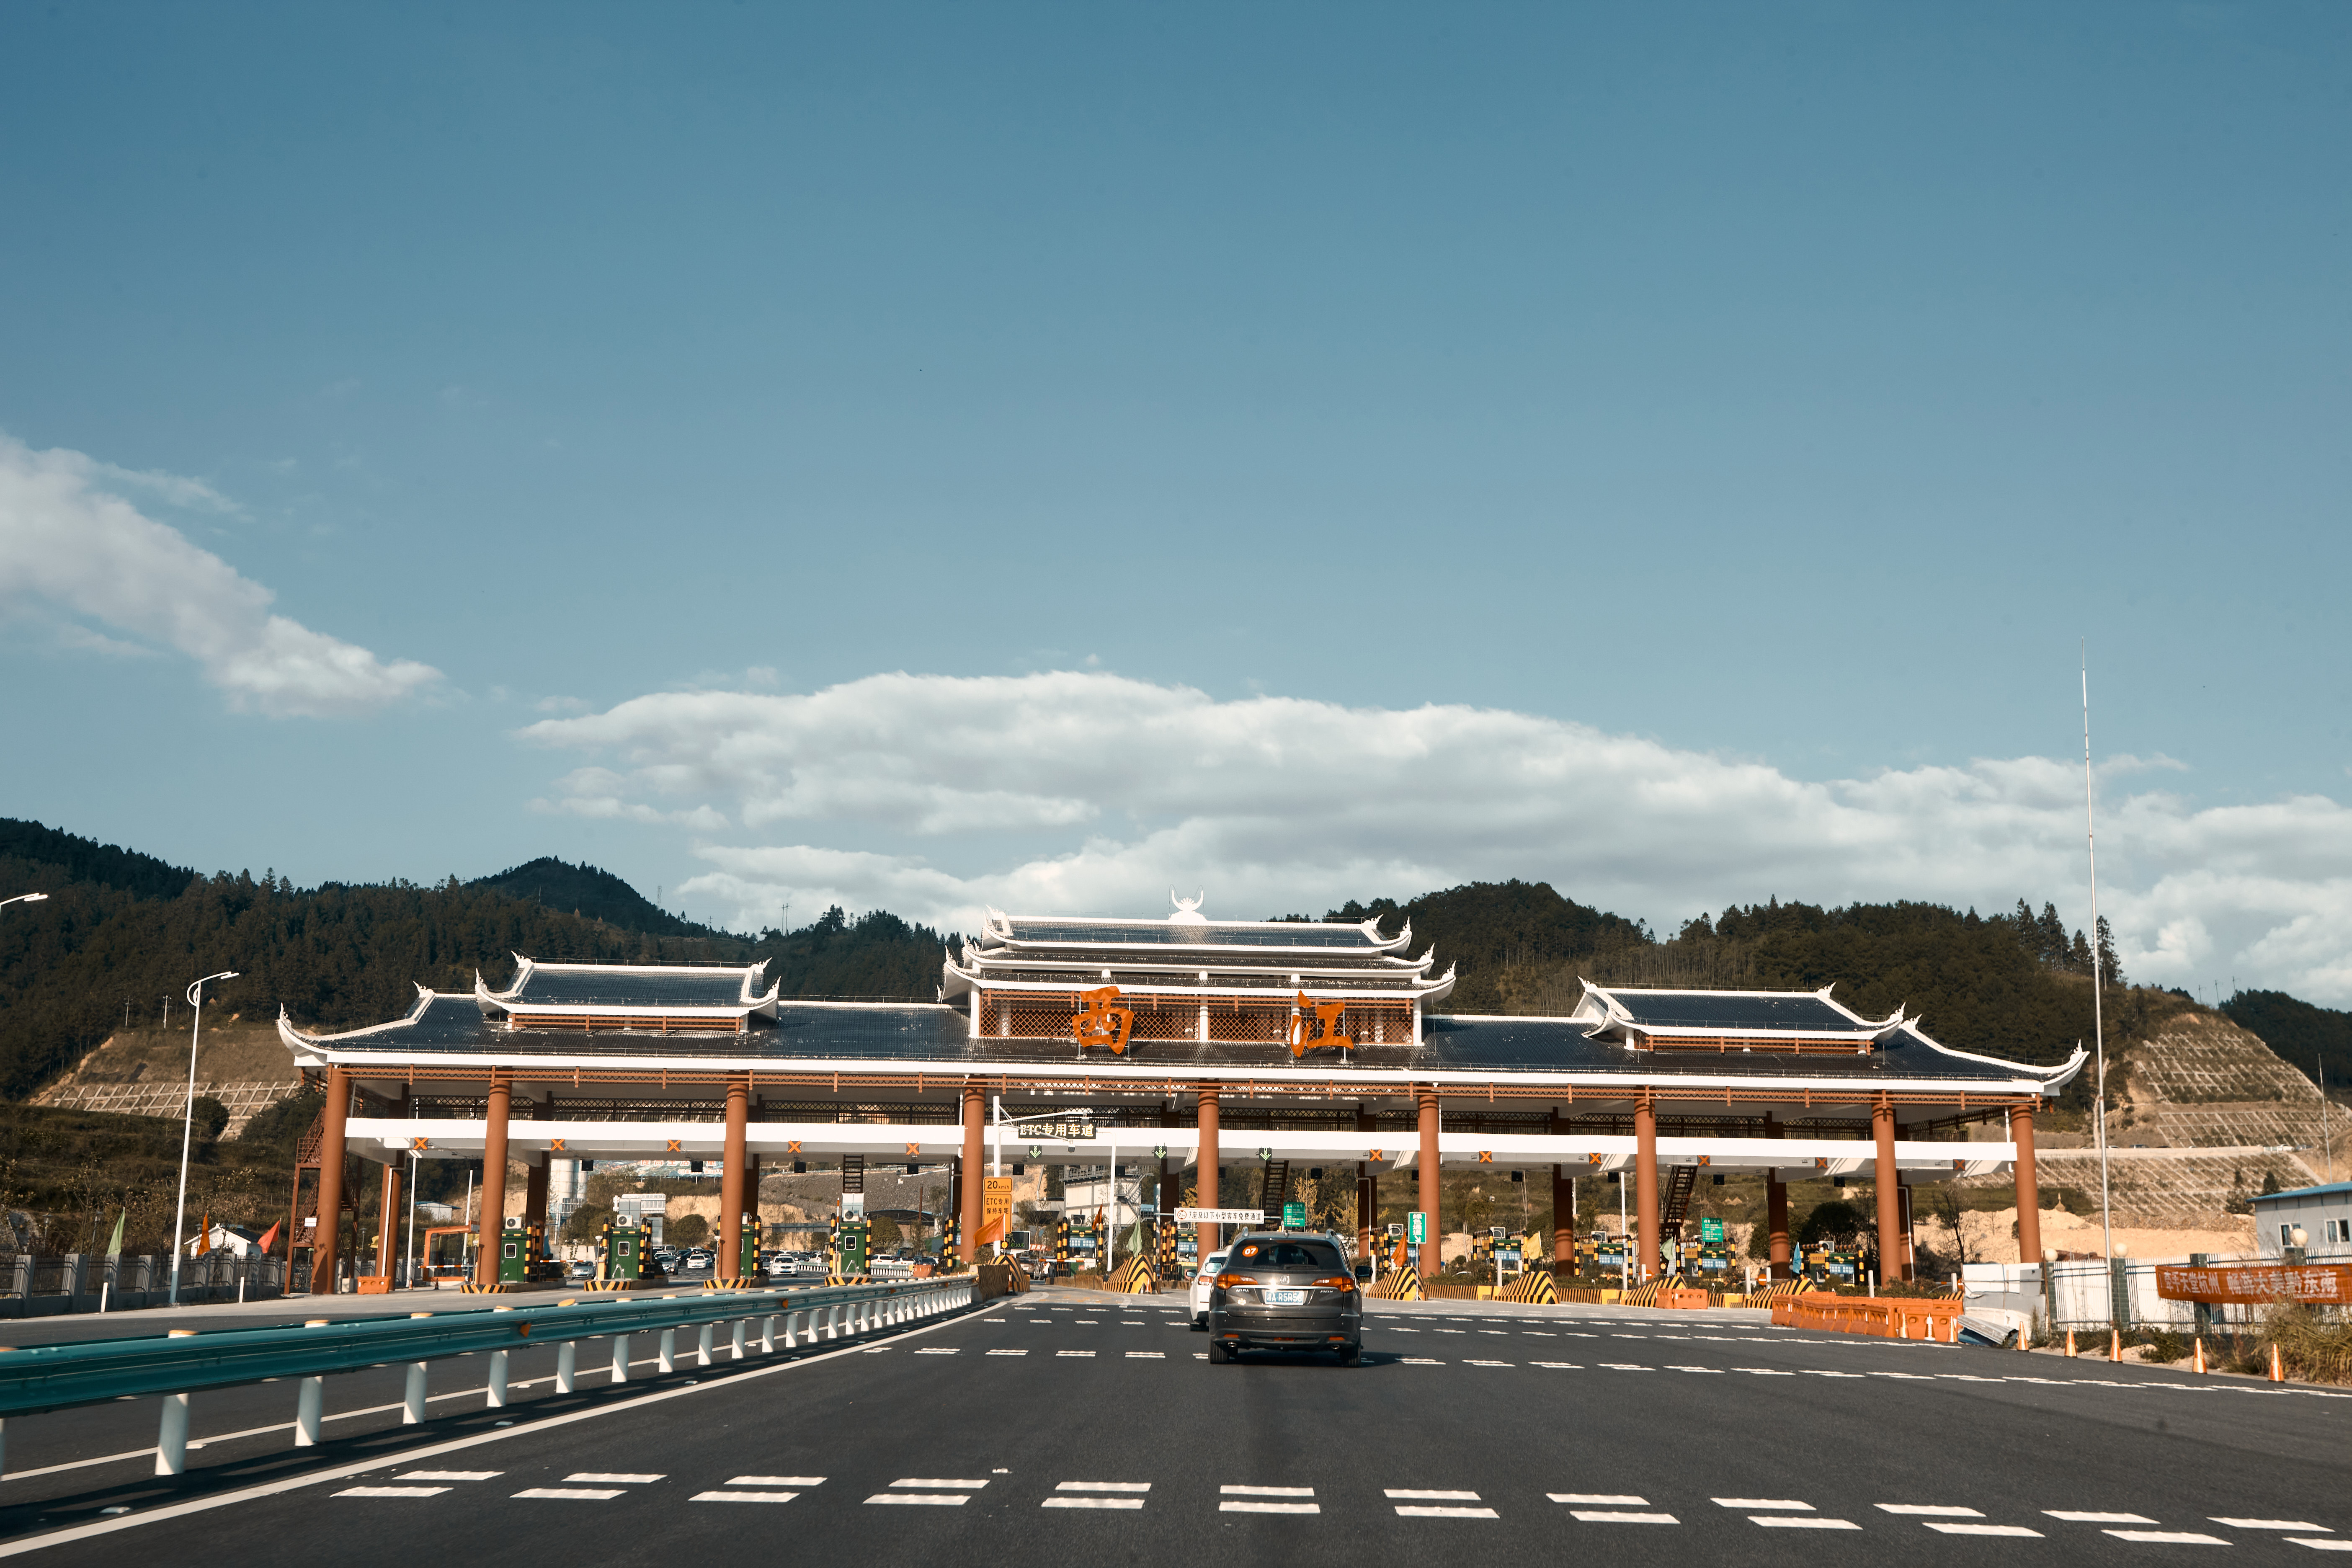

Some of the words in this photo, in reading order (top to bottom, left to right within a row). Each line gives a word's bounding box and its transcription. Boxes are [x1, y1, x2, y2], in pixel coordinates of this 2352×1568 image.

[1071, 985, 1354, 1058] 西江
[1020, 1123, 1094, 1137] ETC专用车道
[1189, 1211, 1261, 1220] 7座及以下小型客车免费通道
[2164, 1271, 2221, 1295] 牵手天堂杭州
[2226, 1269, 2337, 1295] 畅游大美黔东南
